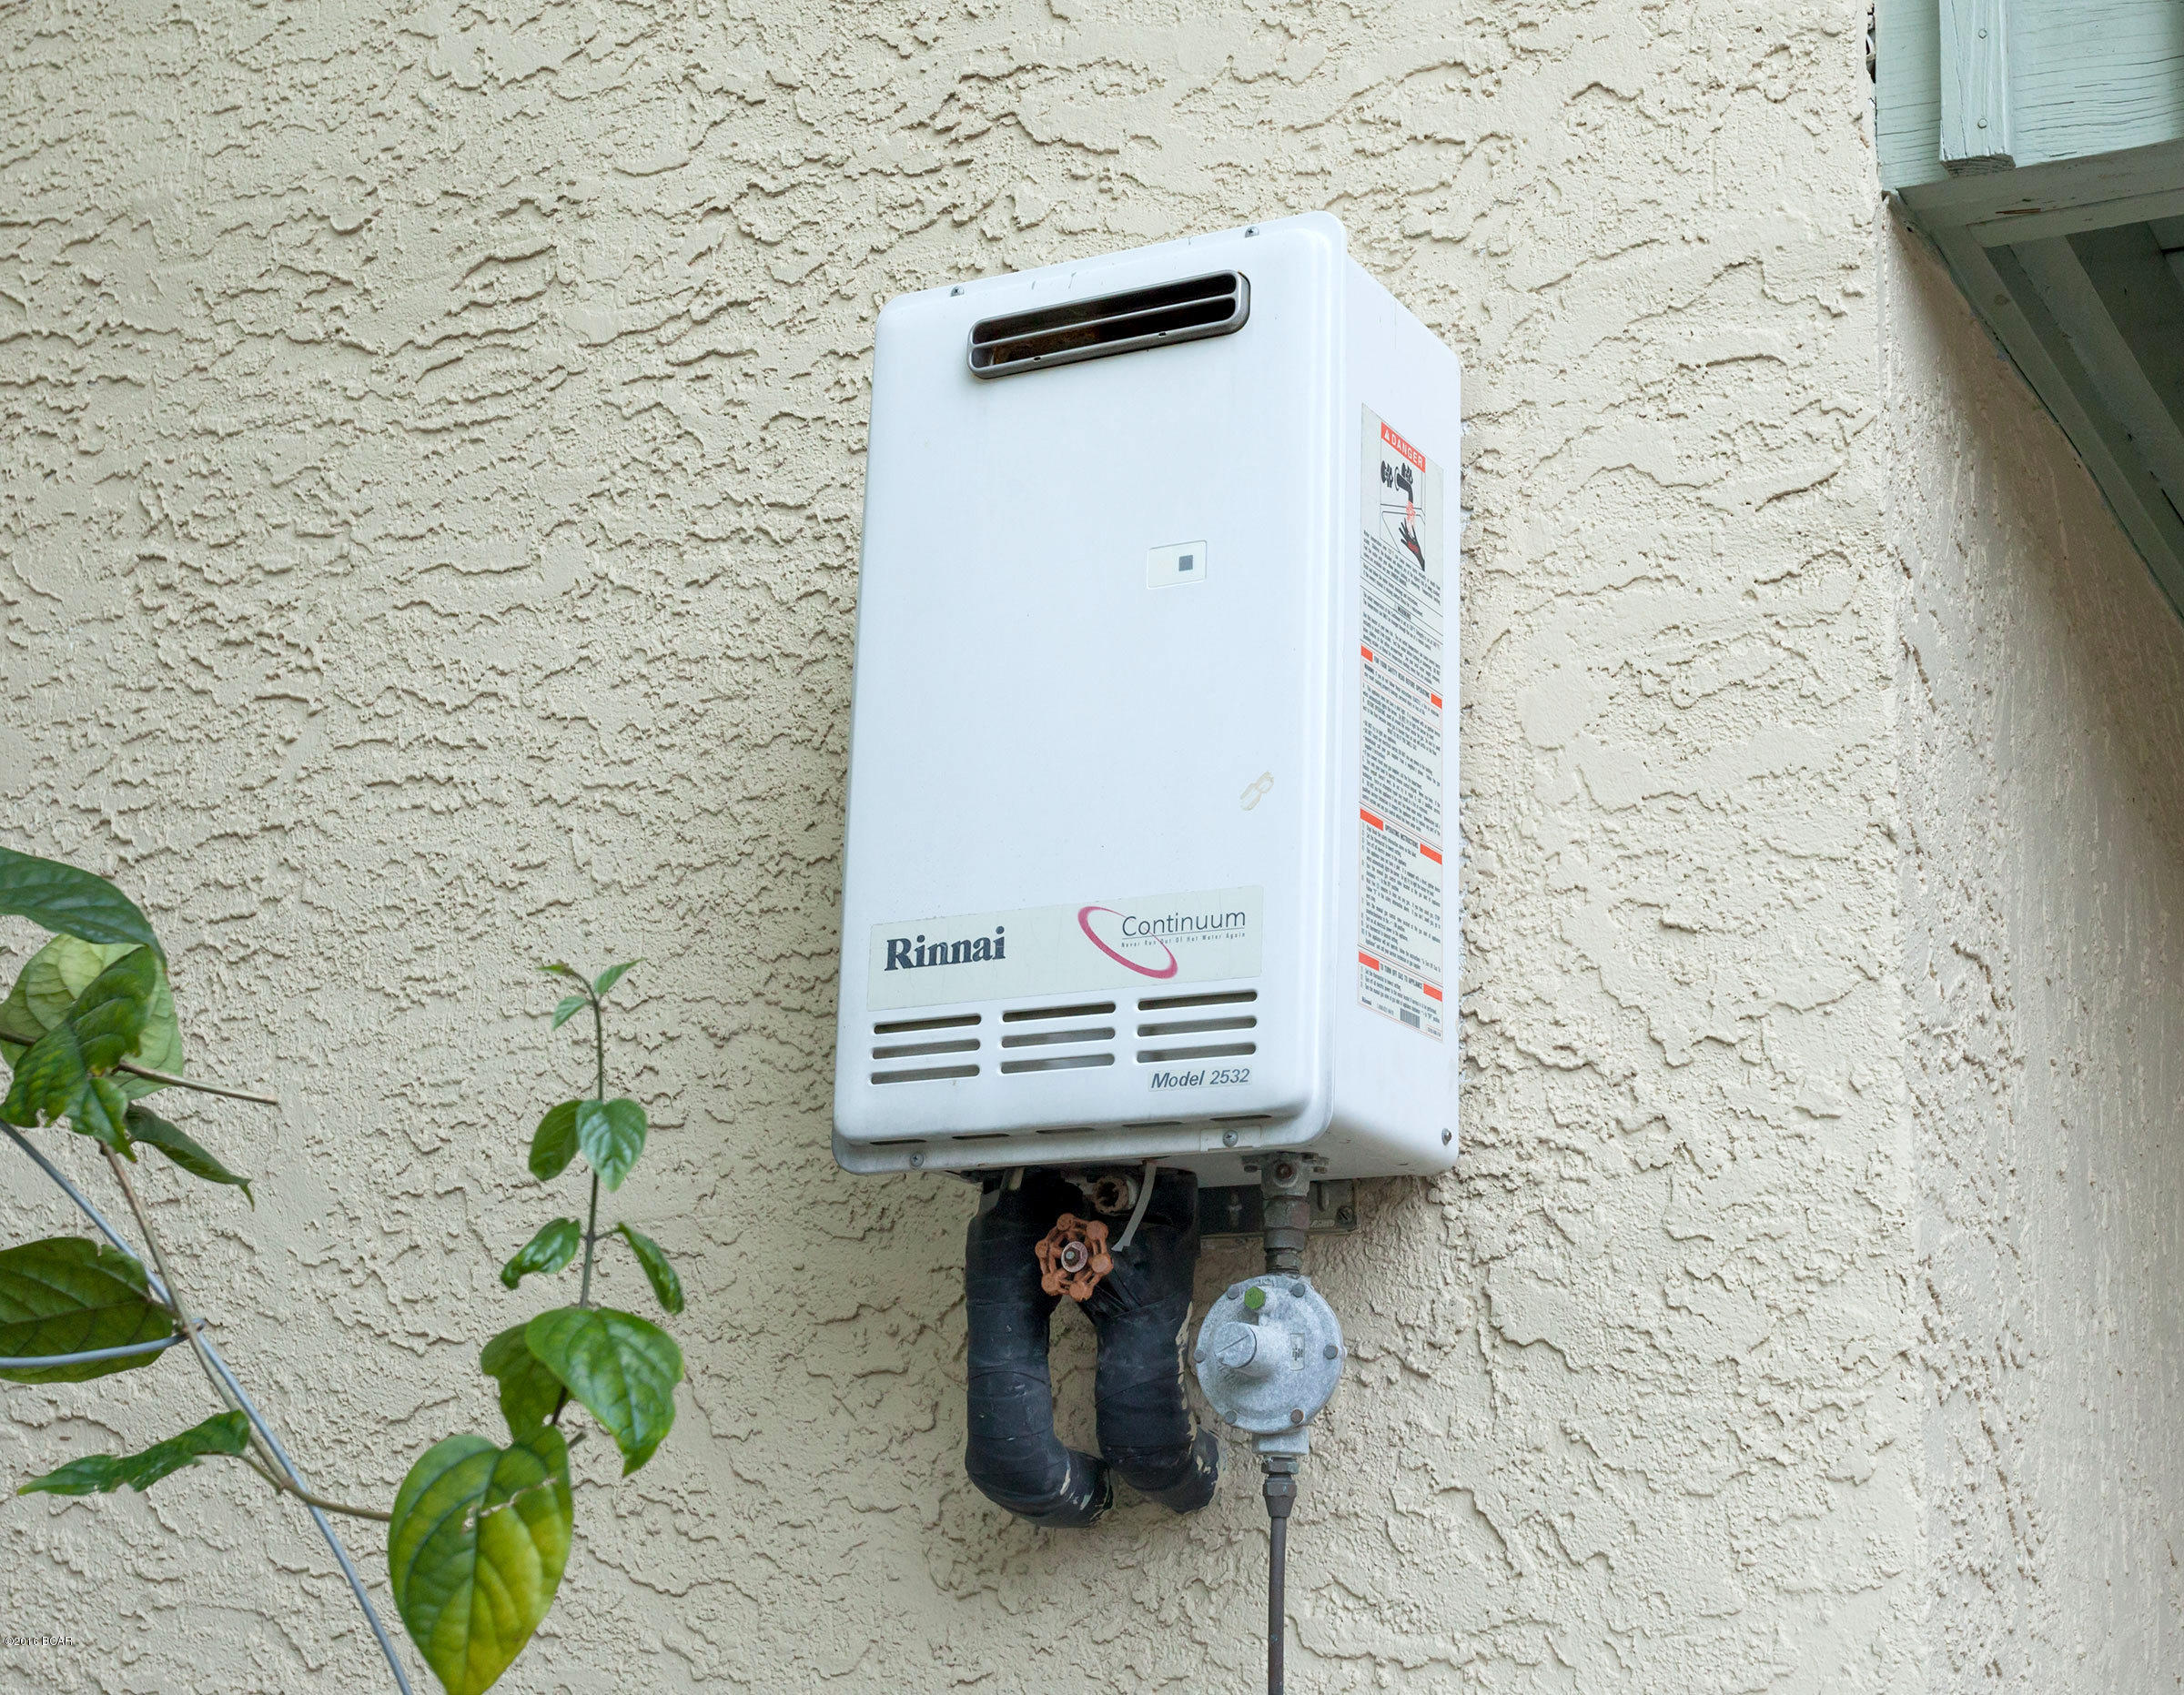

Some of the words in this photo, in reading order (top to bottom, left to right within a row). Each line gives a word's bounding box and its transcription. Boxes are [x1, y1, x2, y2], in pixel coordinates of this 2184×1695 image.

[1391, 433, 1423, 469] DANGER
[1122, 911, 1246, 936] Continuum
[884, 925, 1006, 971] Rinnai
[1151, 1070, 1206, 1088] Model
[1209, 1068, 1250, 1085] 2532
